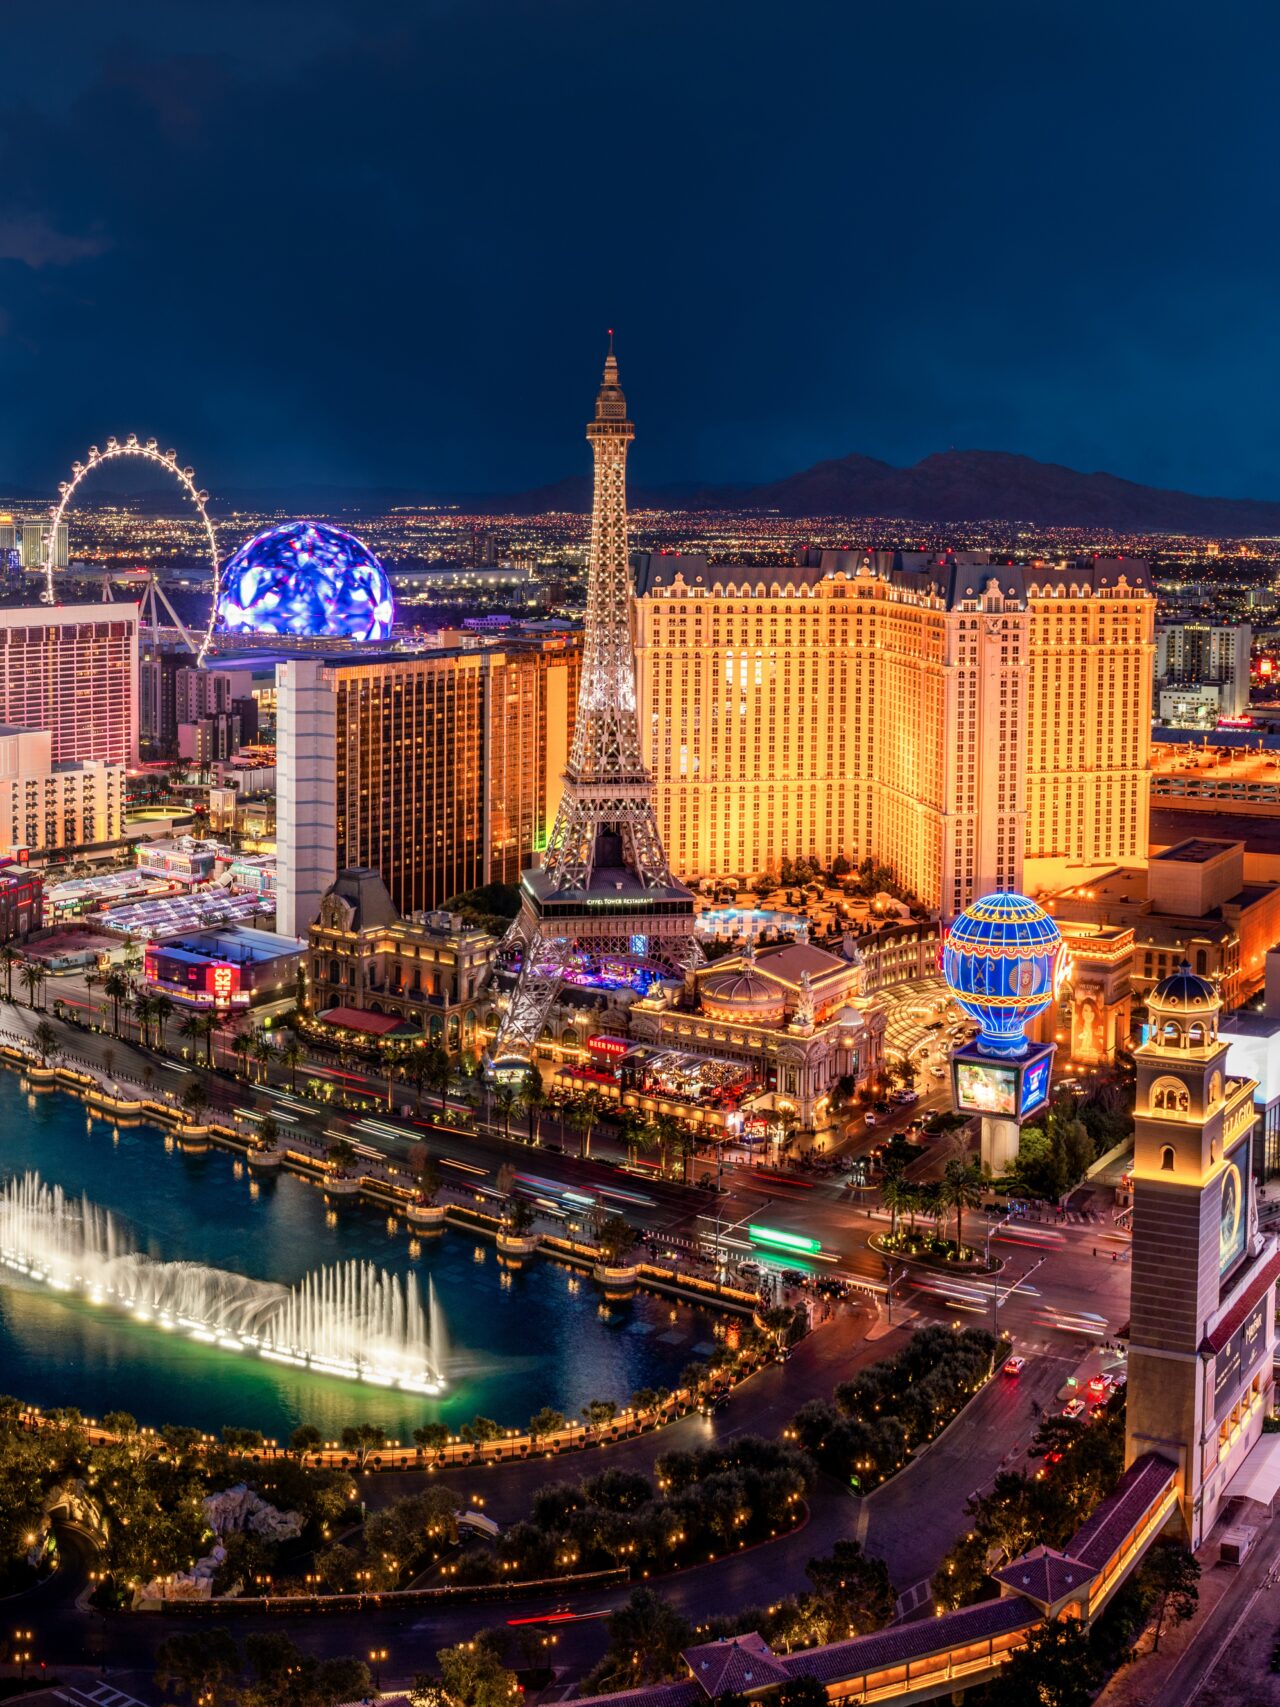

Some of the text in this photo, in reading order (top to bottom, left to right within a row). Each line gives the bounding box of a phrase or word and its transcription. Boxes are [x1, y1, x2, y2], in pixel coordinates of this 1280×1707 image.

[588, 1039, 625, 1053] BEER PARK
[1223, 1100, 1252, 1138] LLAGIO
